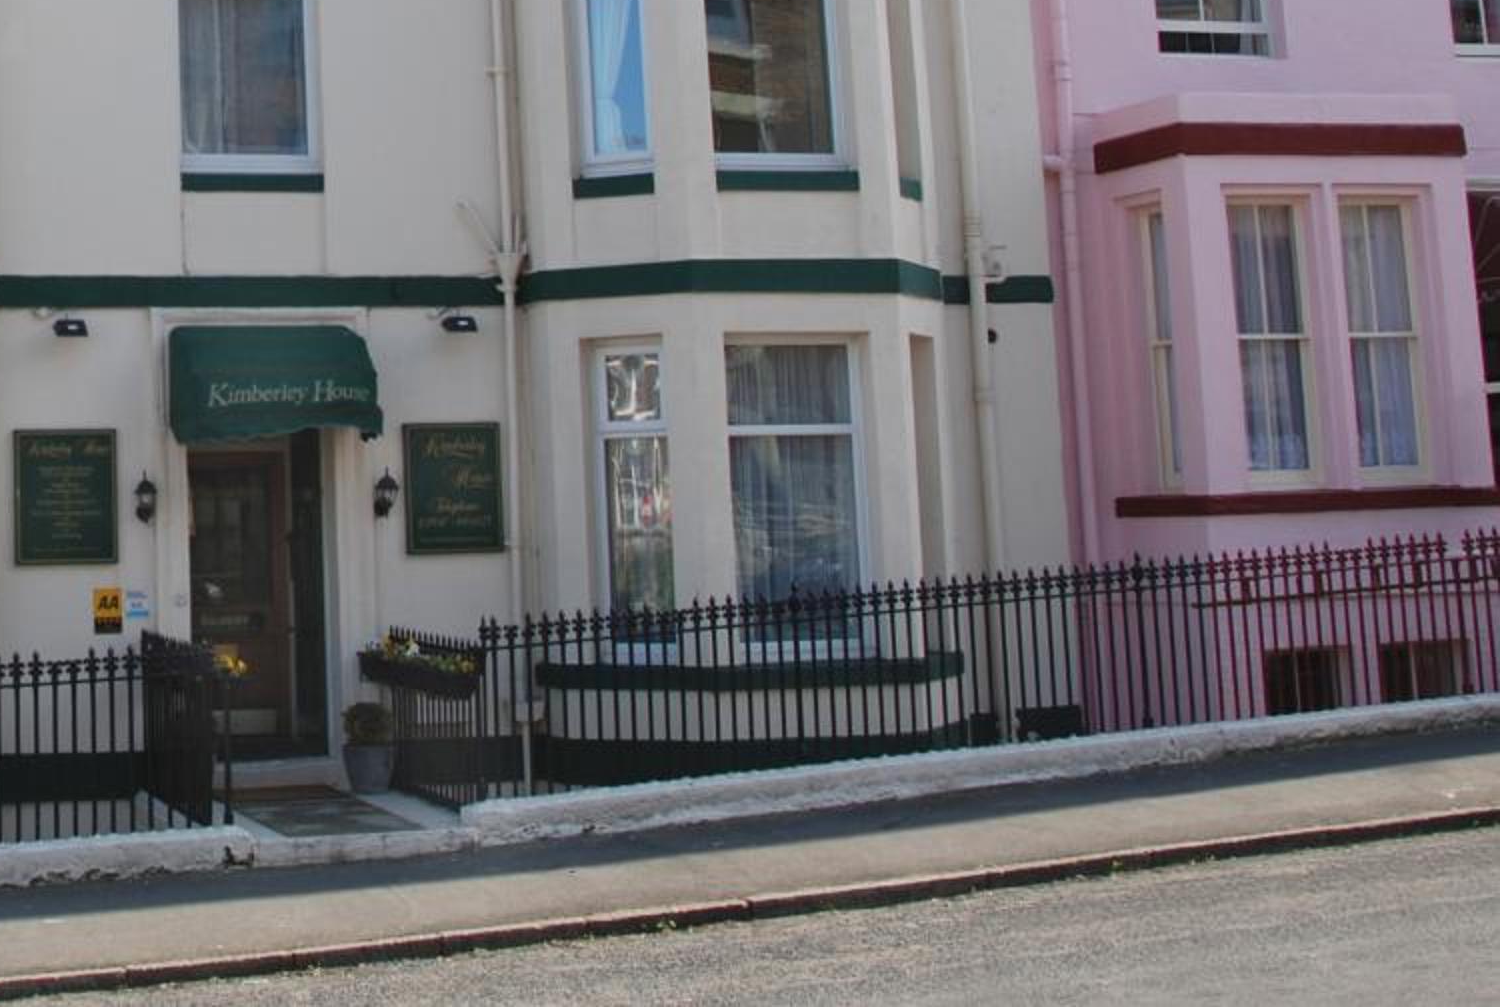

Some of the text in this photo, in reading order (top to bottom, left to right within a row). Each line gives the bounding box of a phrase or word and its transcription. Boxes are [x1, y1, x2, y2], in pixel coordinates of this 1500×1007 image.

[208, 378, 371, 408] Kimberley House
[98, 595, 120, 610] AA
